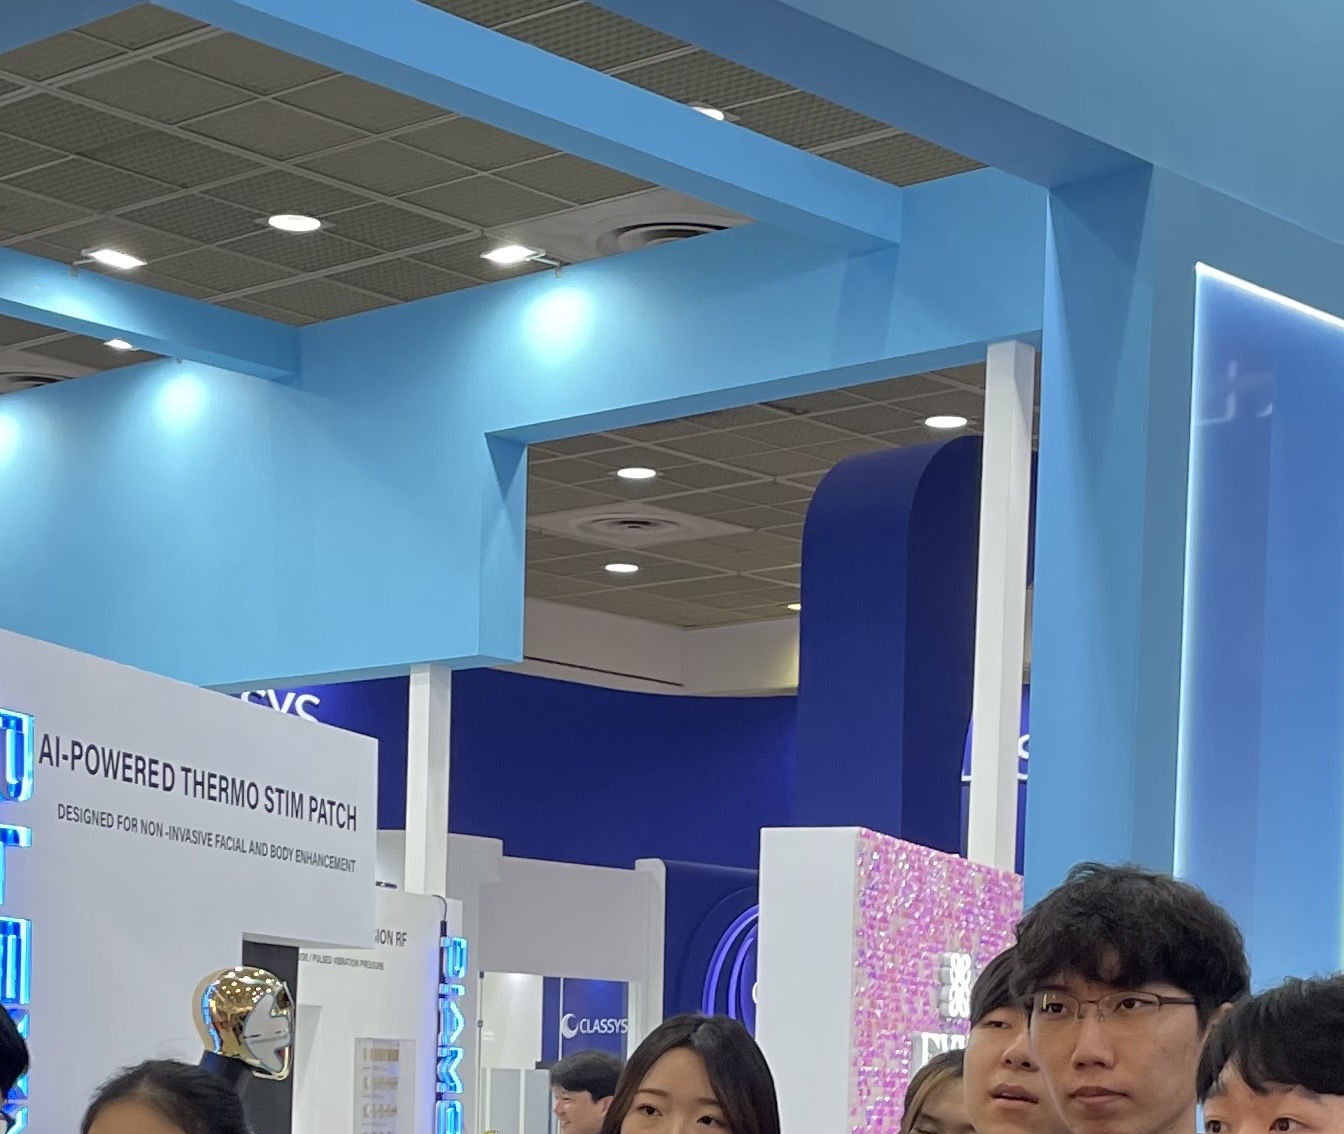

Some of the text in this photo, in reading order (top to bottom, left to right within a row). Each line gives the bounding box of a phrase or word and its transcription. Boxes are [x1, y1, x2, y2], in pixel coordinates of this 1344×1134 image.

[39, 733, 357, 832] AI-POWERED THERMO STIM PATCH
[57, 803, 114, 829] DESIGNED
[117, 815, 138, 834] FOR
[215, 834, 247, 854] FACIAL
[248, 841, 268, 858] AND
[270, 845, 294, 862] BODY
[295, 849, 356, 874] ENHANCEMENT
[396, 931, 408, 947] RF
[579, 1018, 629, 1034] CLASSYS
